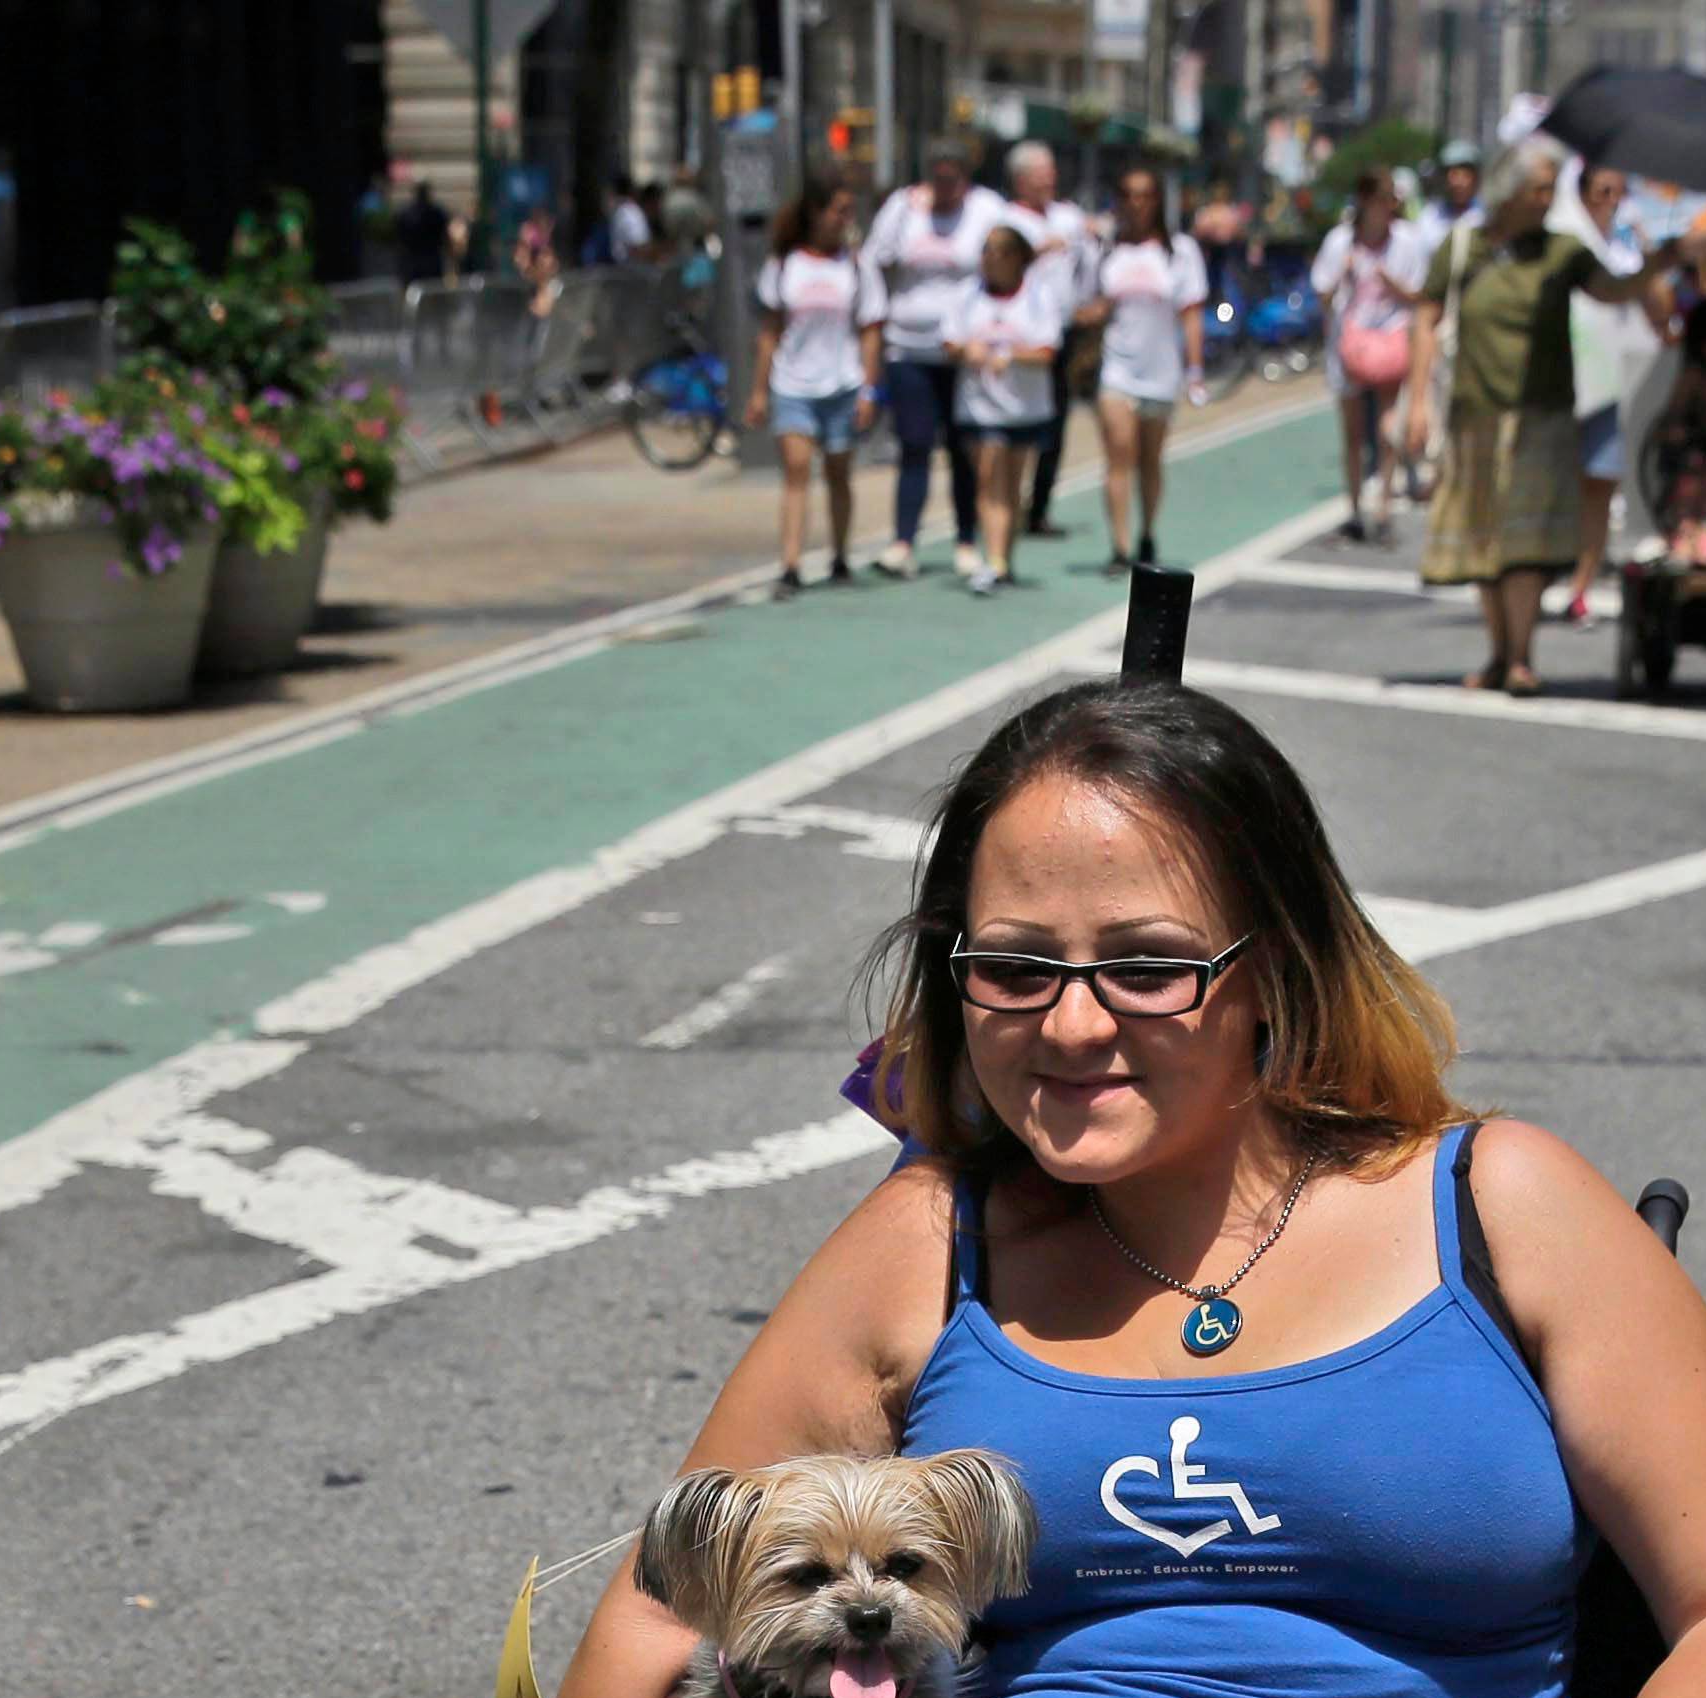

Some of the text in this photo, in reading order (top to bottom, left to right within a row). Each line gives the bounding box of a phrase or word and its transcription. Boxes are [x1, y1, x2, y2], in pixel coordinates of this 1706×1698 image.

[1076, 1563, 1299, 1578] Embrace. Educate. Empower.
